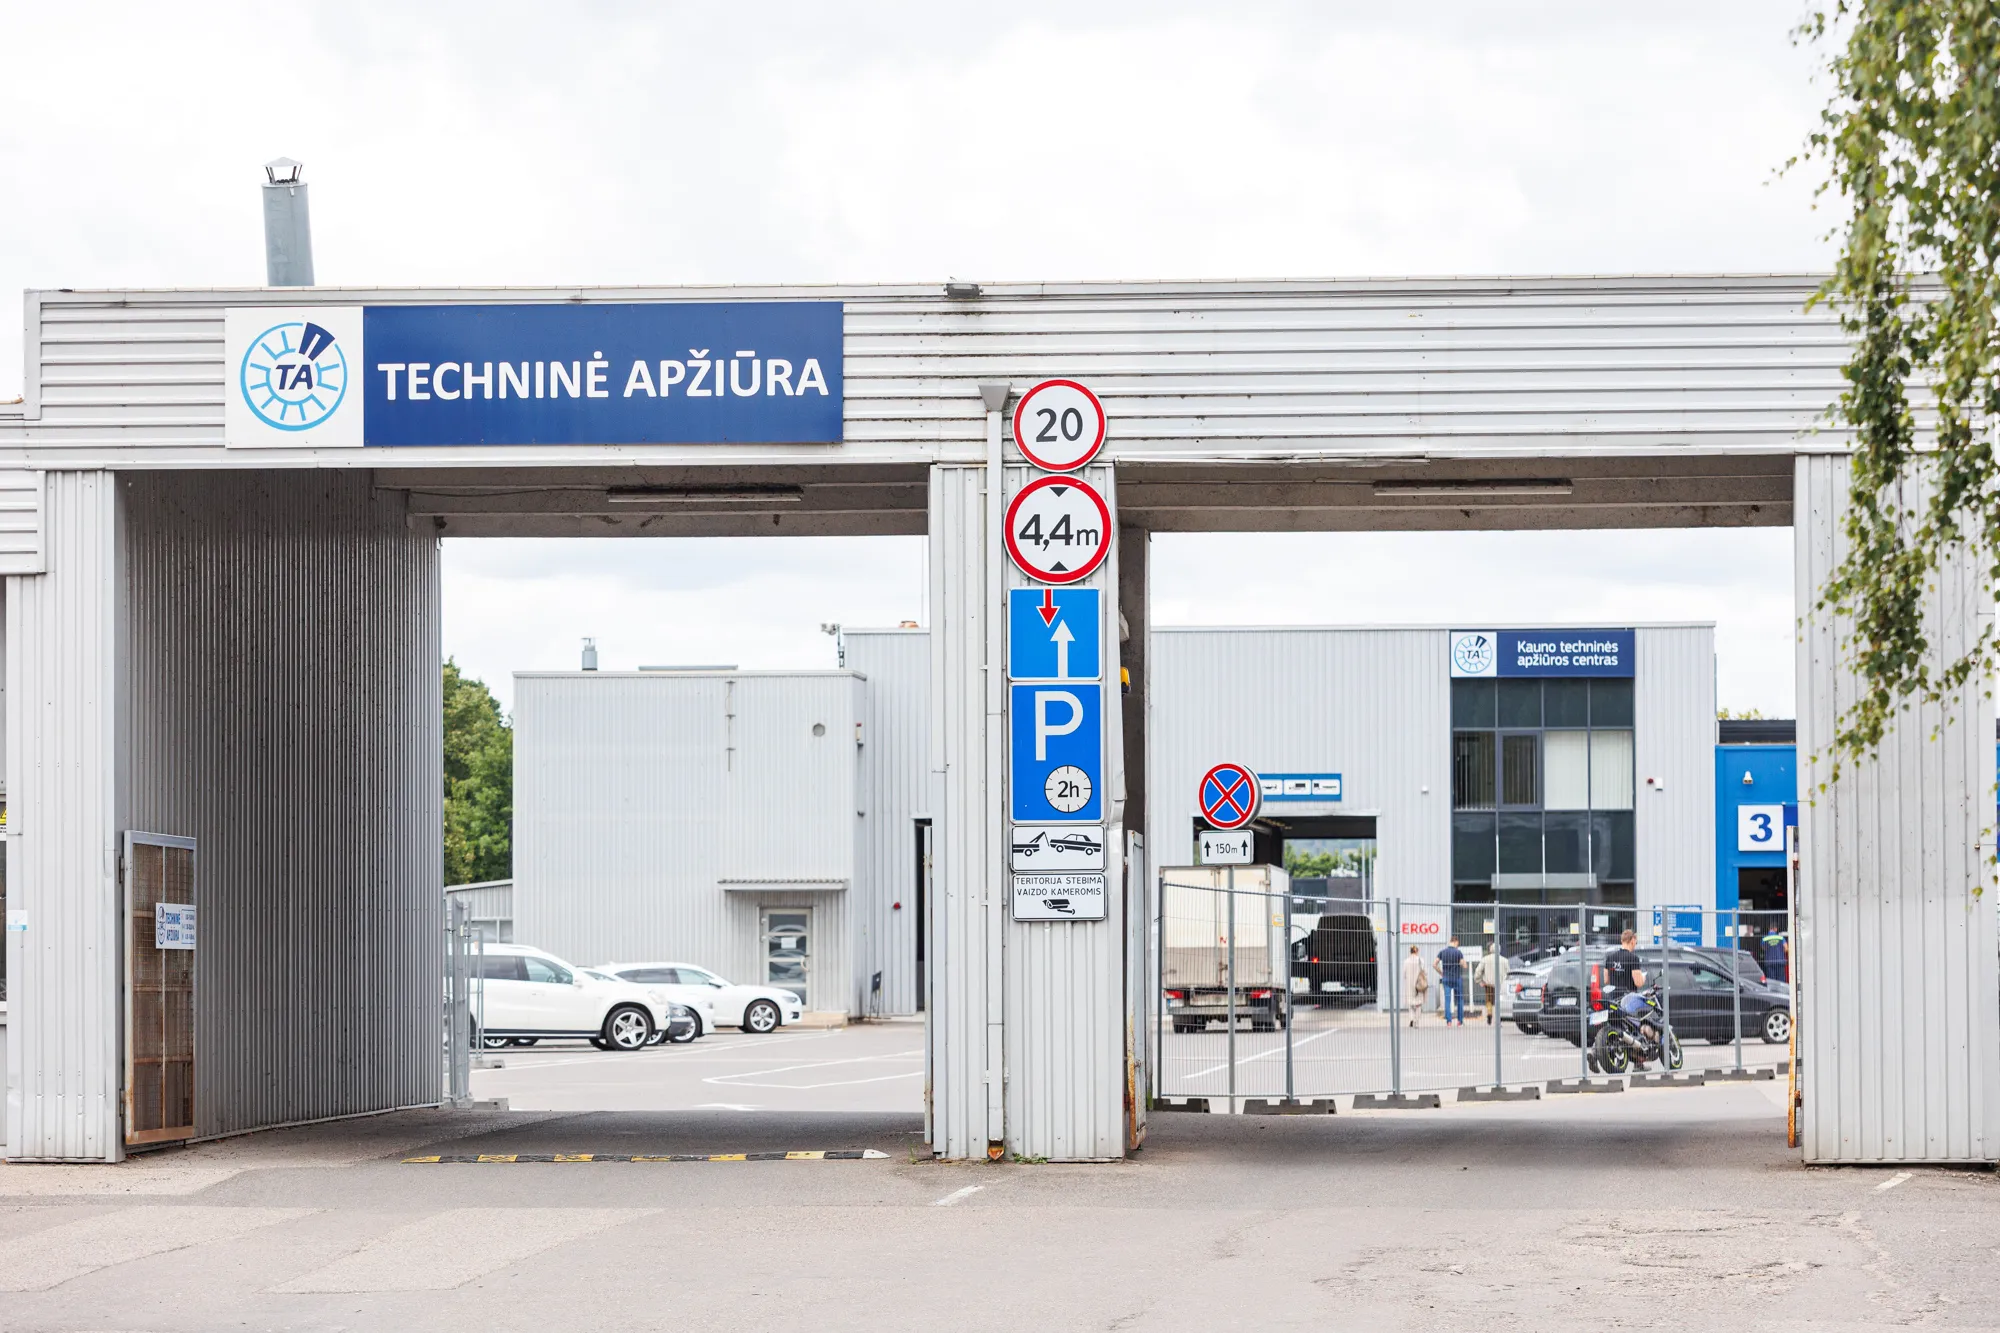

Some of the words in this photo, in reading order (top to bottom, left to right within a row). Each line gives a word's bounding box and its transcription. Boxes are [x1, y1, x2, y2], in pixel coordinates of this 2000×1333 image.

[274, 364, 315, 390] TA
[378, 351, 609, 401] TECHNINĖ
[623, 348, 830, 398] APŽIŪRA
[1036, 407, 1083, 443] 20
[1466, 649, 1481, 659] TA
[1517, 640, 1557, 653] Kauno
[1559, 639, 1619, 653] techninės
[1517, 654, 1570, 668] apžiūros
[1572, 654, 1619, 666] centras
[1036, 691, 1083, 760] P
[1058, 780, 1080, 798] 2h
[1750, 813, 1774, 844] 3
[1016, 876, 1062, 885] TERITORIJA
[1065, 876, 1102, 885] STEBIMA
[1017, 888, 1048, 896] VAIZDO
[1050, 887, 1101, 896] KAMEROMIS
[1402, 922, 1440, 935] ERGO
